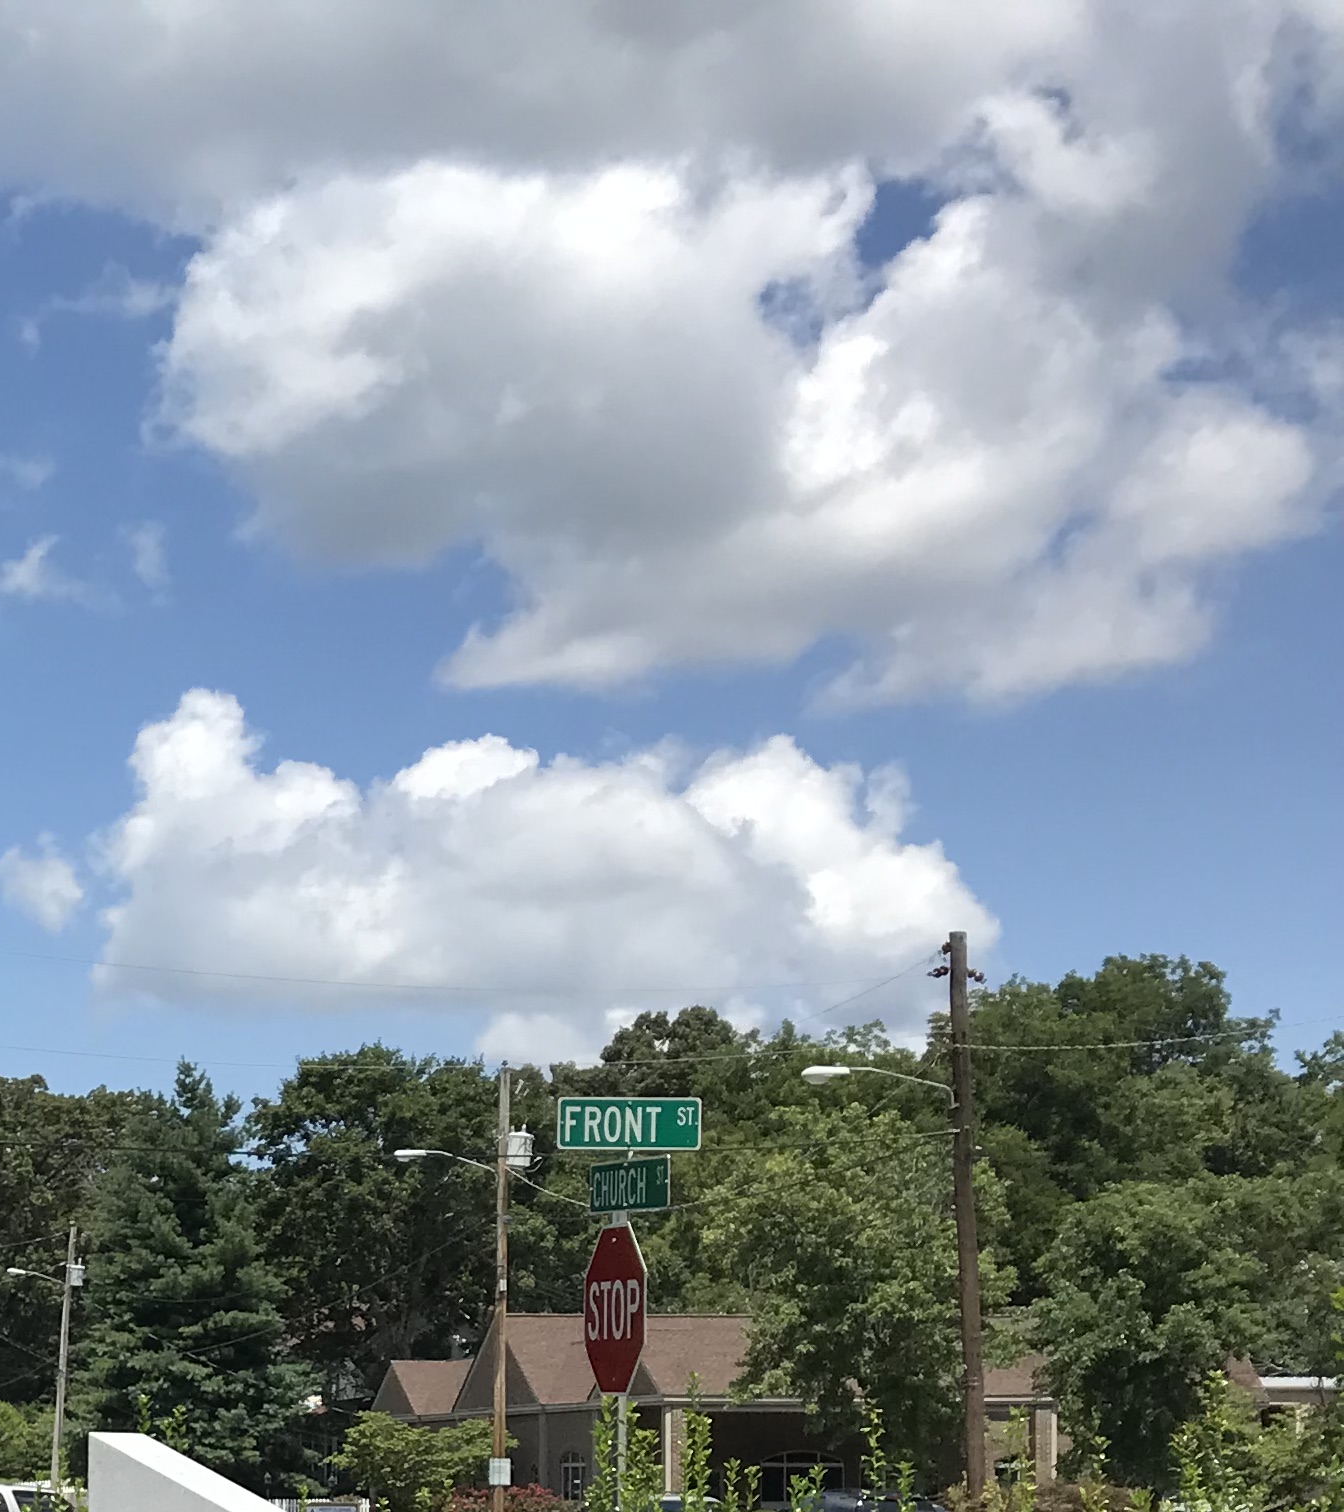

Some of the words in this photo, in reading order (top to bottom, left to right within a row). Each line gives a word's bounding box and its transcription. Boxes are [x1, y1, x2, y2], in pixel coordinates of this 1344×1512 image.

[564, 1105, 662, 1143] FRONT
[593, 1167, 647, 1208] CHURCH
[587, 1278, 640, 1341] STOP
